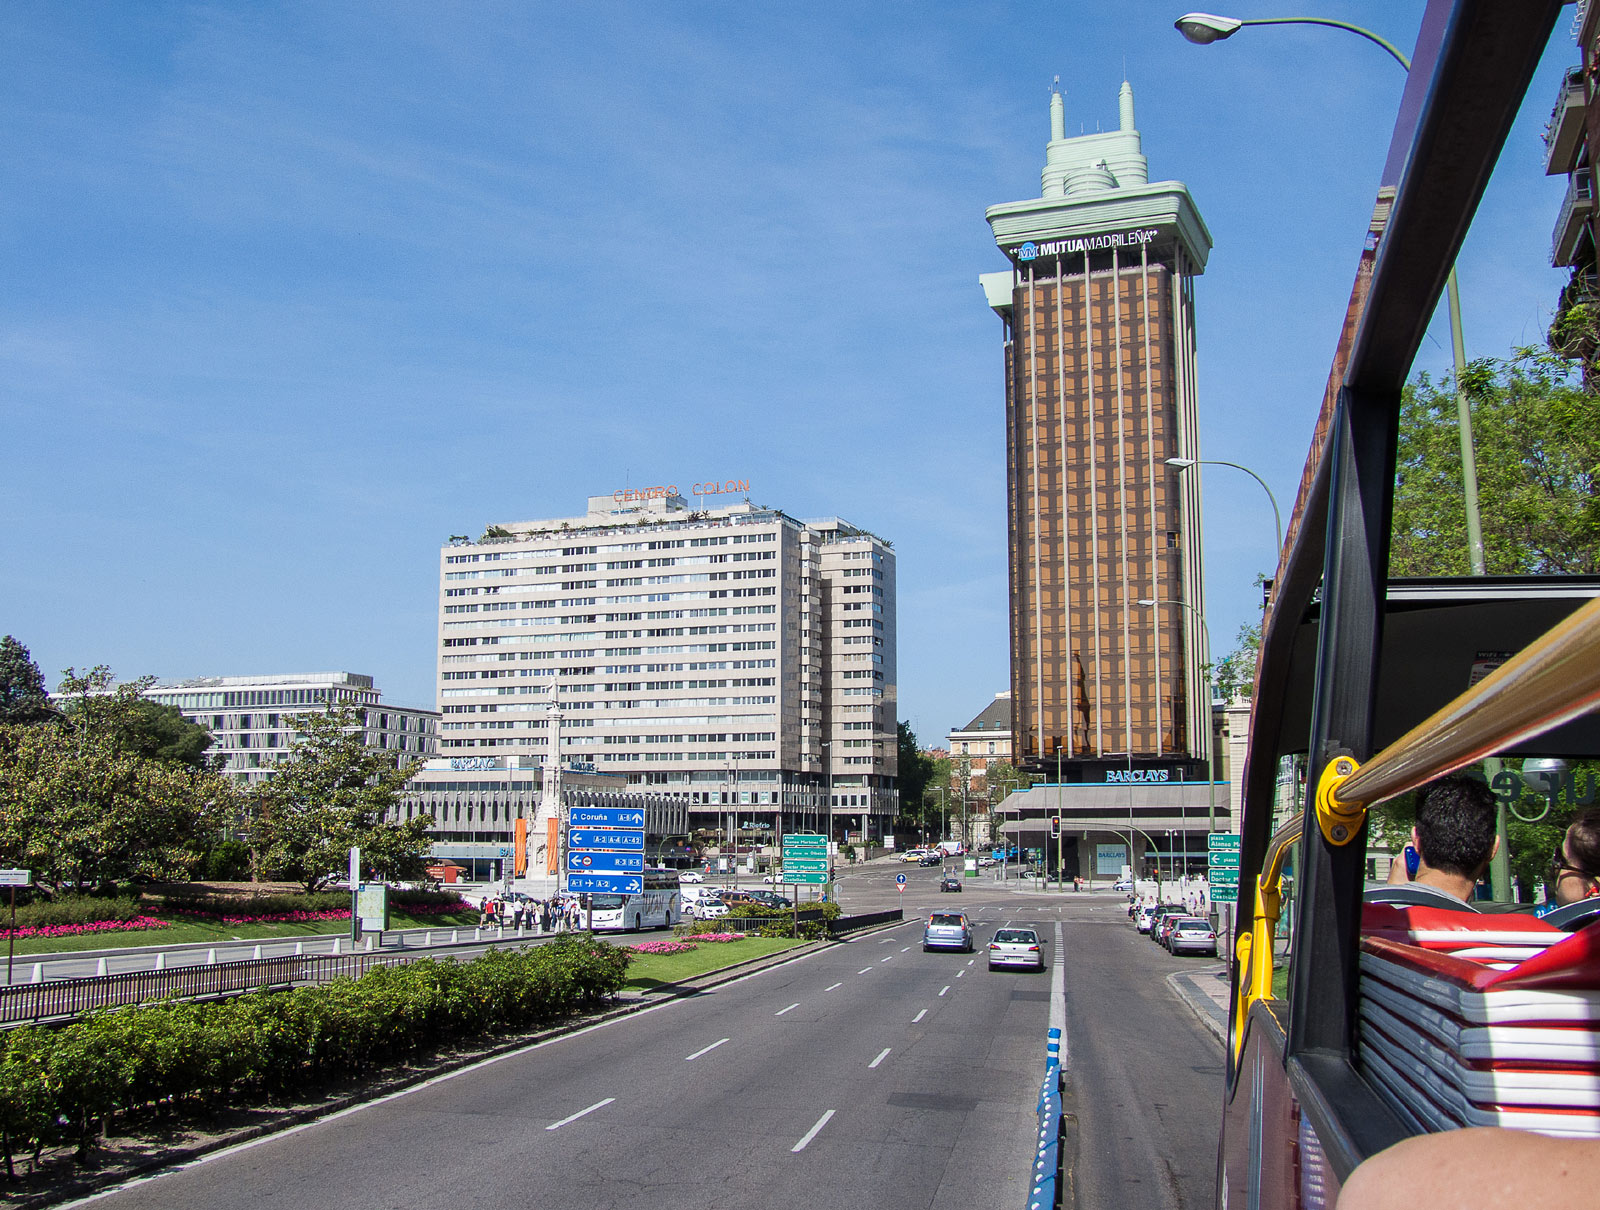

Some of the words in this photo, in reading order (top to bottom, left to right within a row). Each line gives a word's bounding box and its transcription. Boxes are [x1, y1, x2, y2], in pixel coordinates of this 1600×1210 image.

[613, 485, 678, 502] CENTRO
[450, 758, 495, 769] BARCLAYS
[1106, 769, 1169, 782] BARCLAYS
